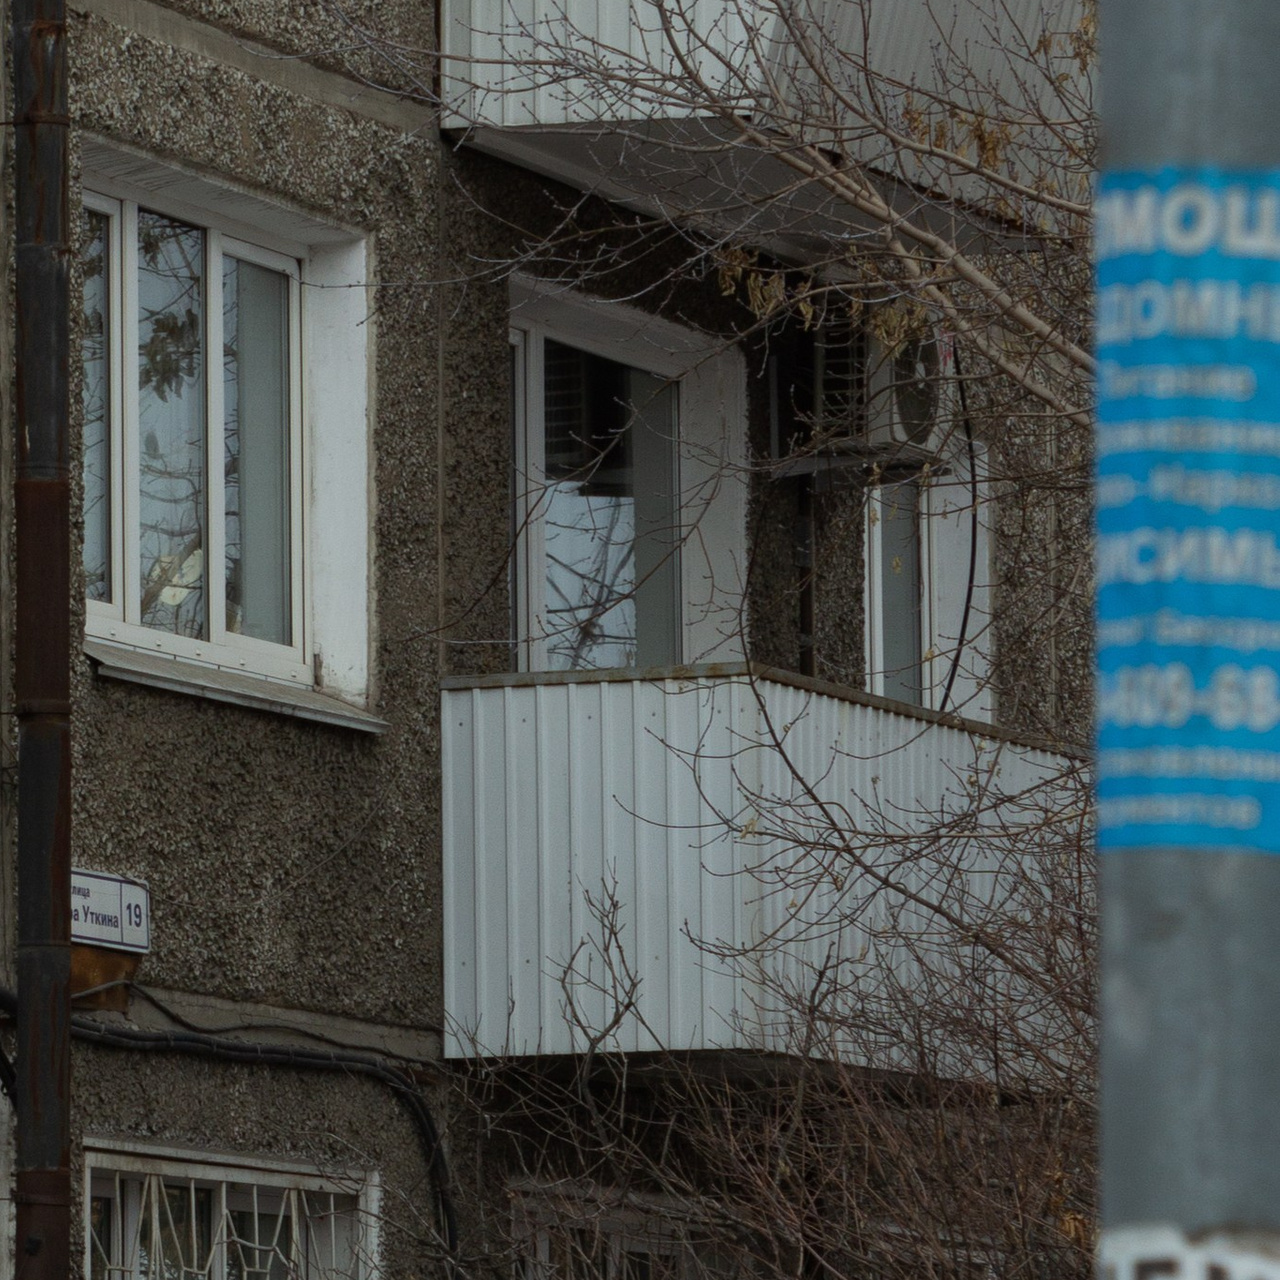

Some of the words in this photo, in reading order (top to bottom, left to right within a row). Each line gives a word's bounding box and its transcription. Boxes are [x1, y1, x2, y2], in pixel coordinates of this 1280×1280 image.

[71, 885, 91, 899] лица
[82, 904, 120, 929] Уткина
[125, 902, 143, 928] 19
